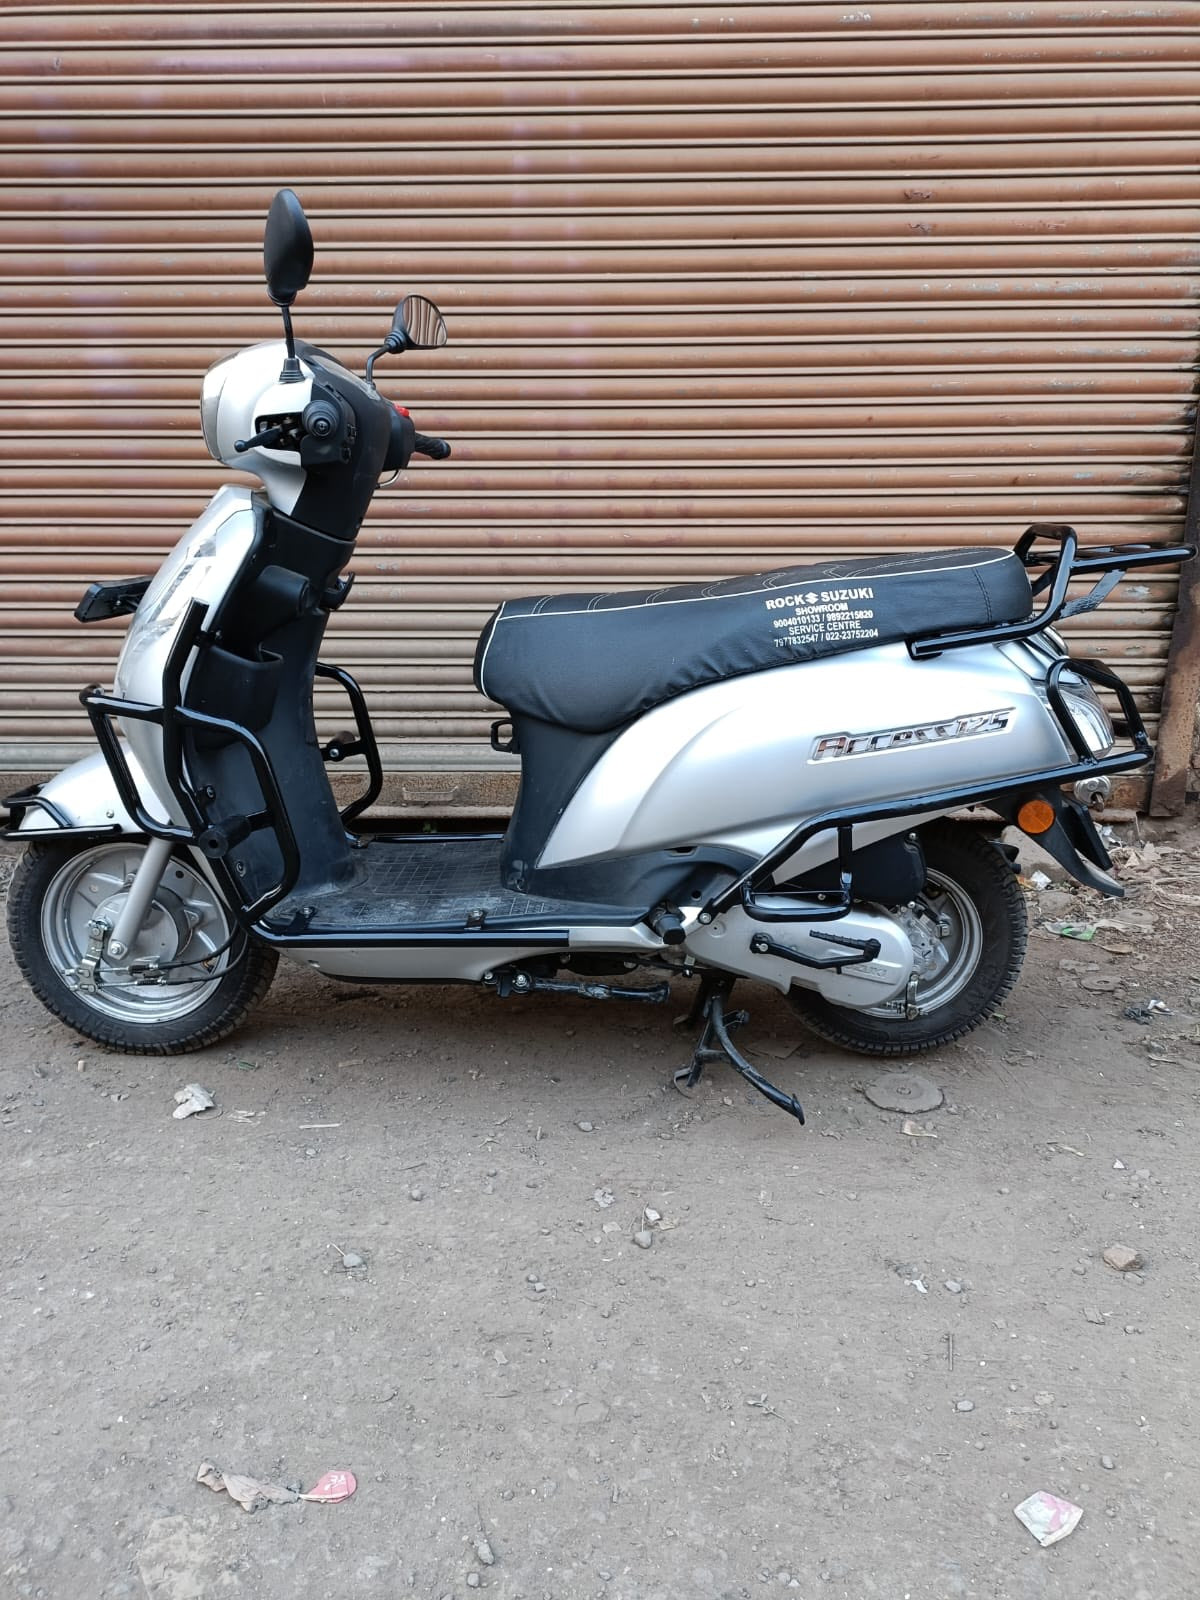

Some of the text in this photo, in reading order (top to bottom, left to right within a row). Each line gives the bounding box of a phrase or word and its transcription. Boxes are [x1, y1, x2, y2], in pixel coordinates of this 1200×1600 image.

[765, 587, 874, 610] ROCK SUZUKI
[795, 602, 849, 616] SHOWROOM
[773, 614, 821, 628] 9004010133
[788, 620, 861, 636] SERVICE CENTRE
[825, 629, 879, 641] 022-23752204
[956, 711, 1011, 738] 125
